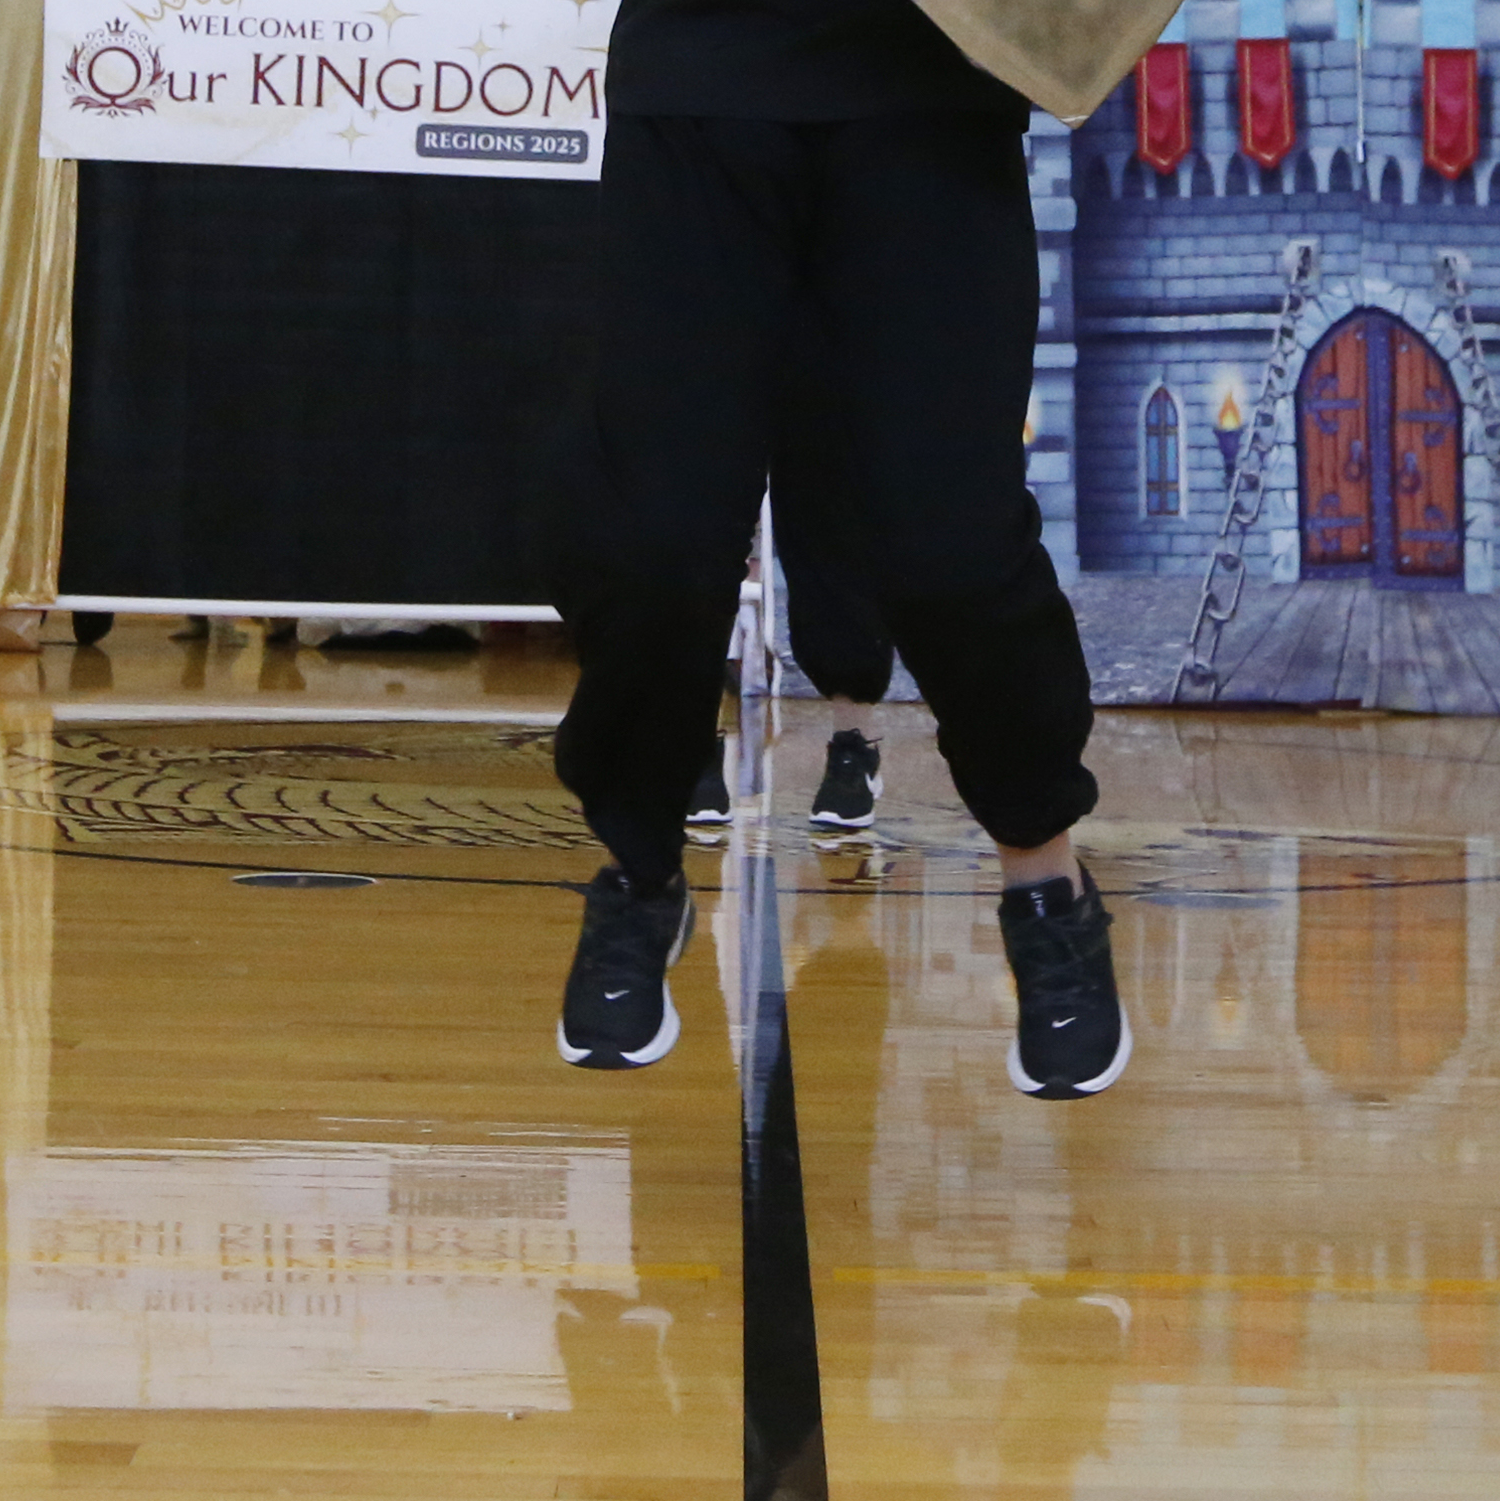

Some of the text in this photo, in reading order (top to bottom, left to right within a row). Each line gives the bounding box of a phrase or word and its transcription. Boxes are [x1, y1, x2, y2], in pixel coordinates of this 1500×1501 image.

[179, 14, 374, 43] WELCOME TO
[86, 45, 601, 120] Our KINGDOM
[423, 131, 582, 156] REGIONS 2025
